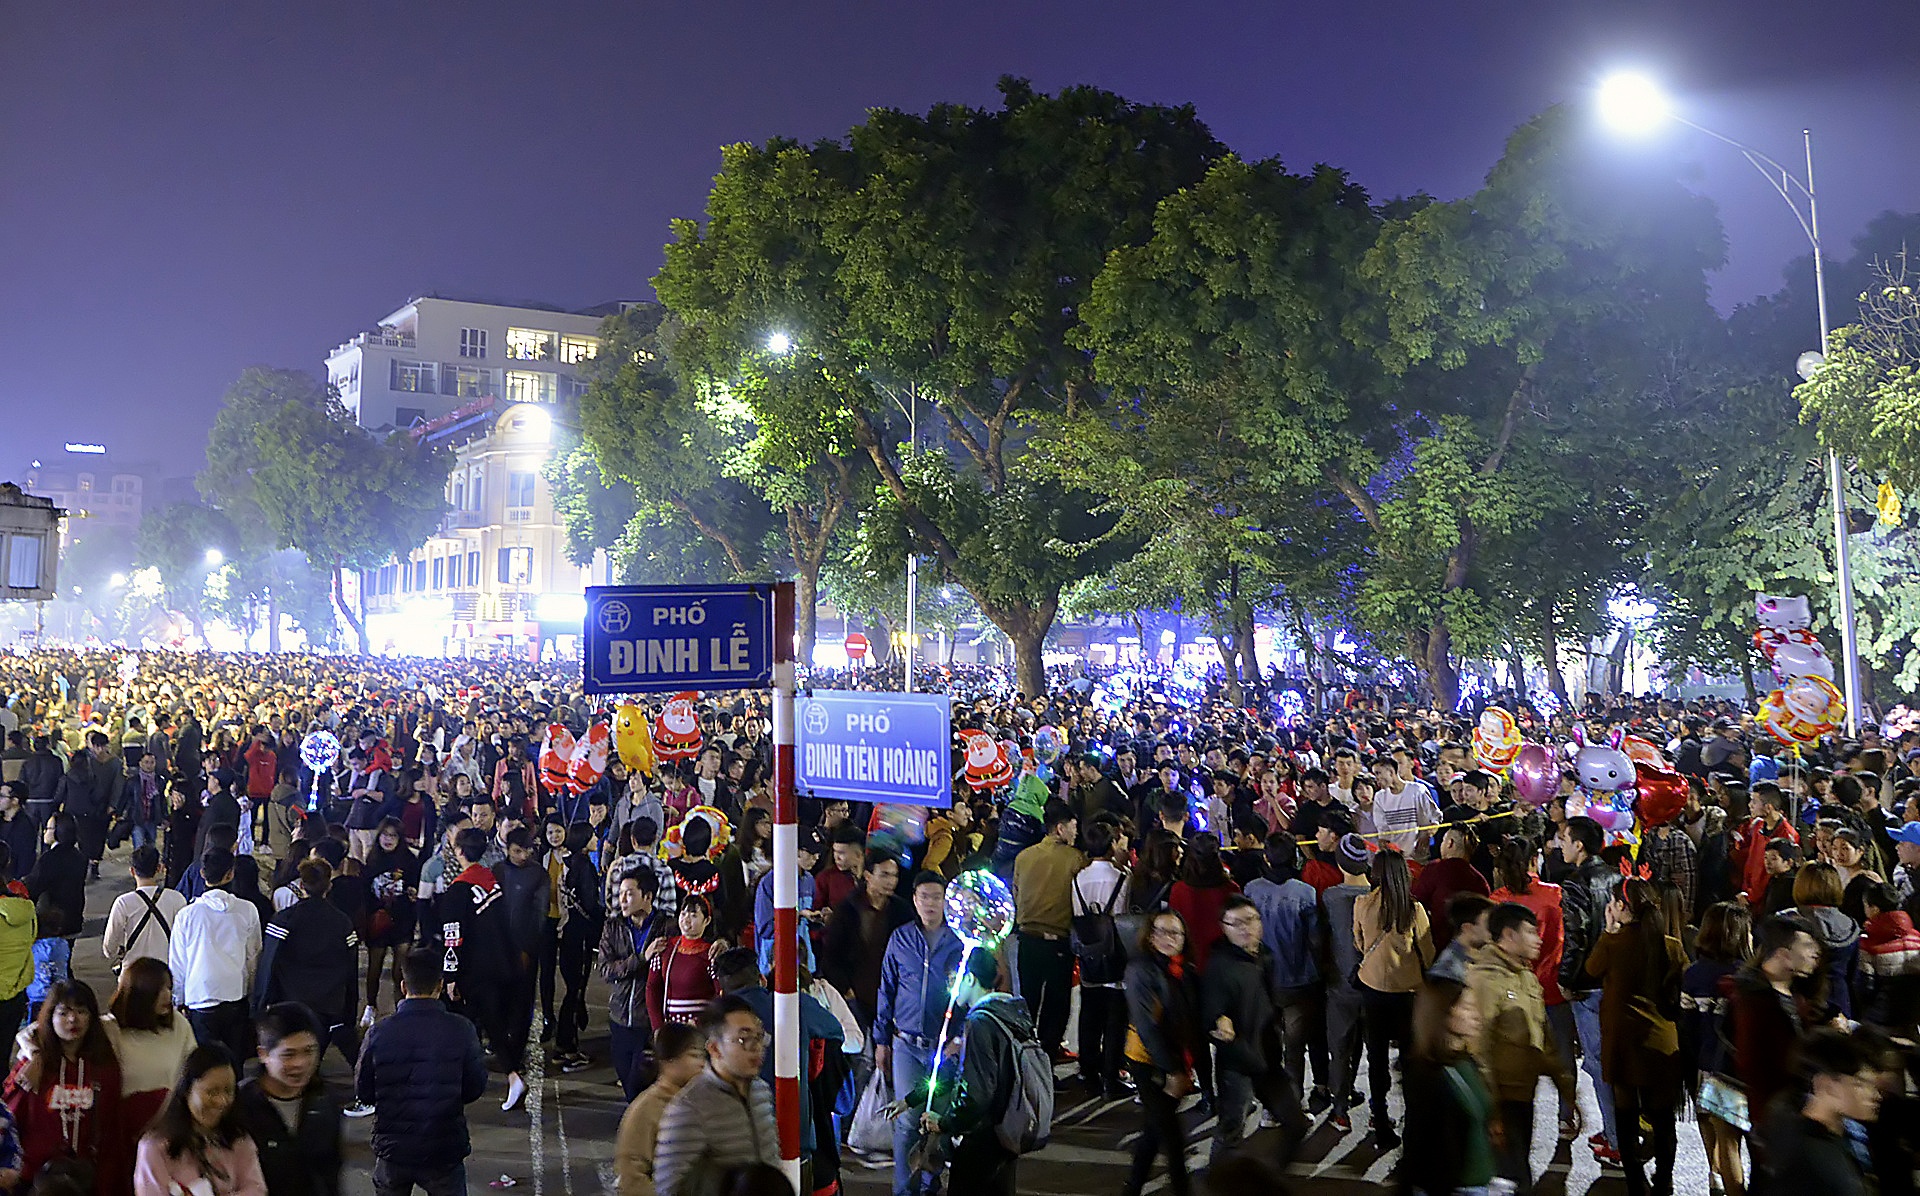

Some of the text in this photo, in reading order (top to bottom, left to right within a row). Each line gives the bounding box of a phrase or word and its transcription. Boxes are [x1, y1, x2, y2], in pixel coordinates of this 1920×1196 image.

[653, 598, 707, 625] PHỐ
[609, 622, 750, 675] ĐINH LỄ
[847, 708, 891, 733] PHỐ
[805, 739, 938, 787] ĐINH TIÊN HOÀNG
